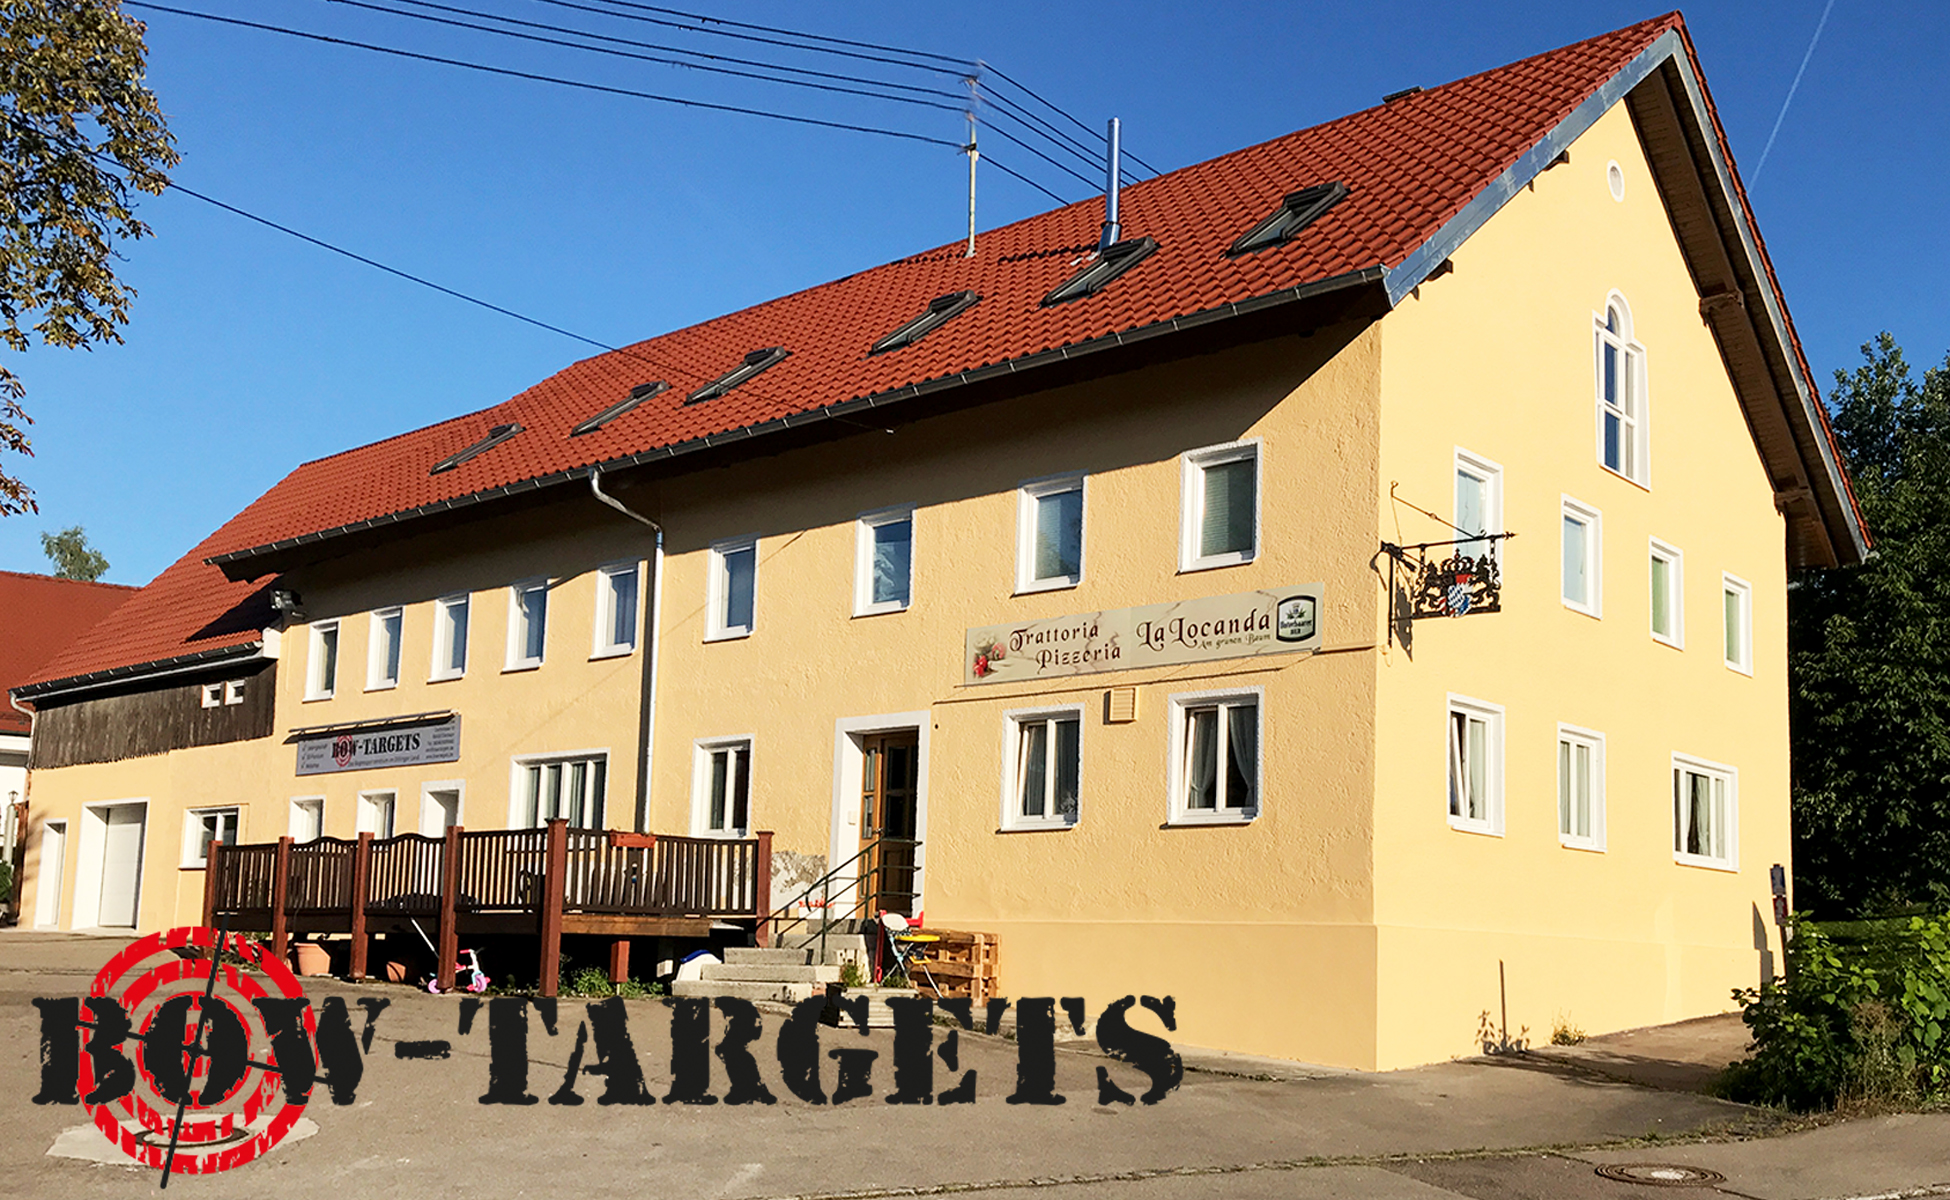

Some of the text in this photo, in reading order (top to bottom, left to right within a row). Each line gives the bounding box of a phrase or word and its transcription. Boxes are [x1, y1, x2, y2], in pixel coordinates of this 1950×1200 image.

[1009, 622, 1099, 652] Trattoria
[1136, 608, 1271, 652] La Locanda
[1036, 643, 1121, 675] Pizzeria
[331, 733, 421, 759] BOW-TARGETS
